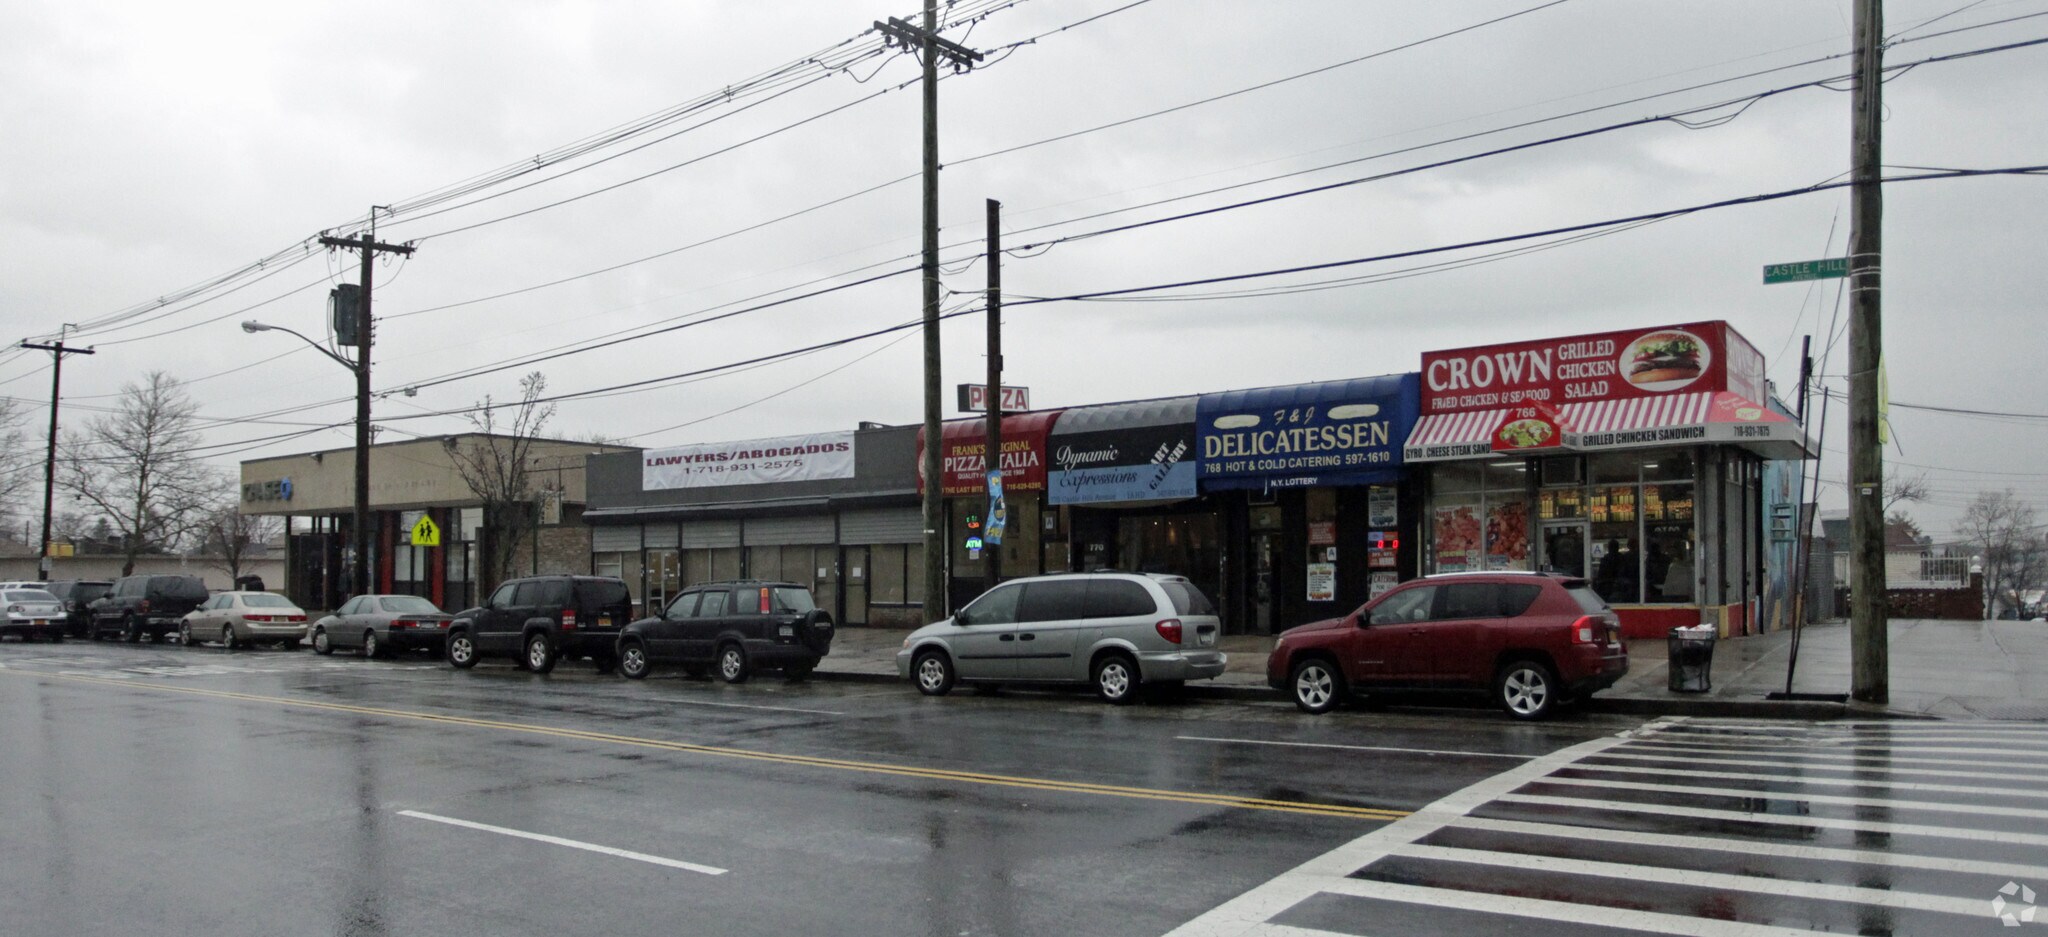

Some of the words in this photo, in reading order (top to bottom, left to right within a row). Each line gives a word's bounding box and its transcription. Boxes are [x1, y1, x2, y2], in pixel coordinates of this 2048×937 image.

[1765, 264, 1810, 277] CASTLE
[1817, 260, 1846, 272] HILL
[1558, 339, 1615, 360] GRILLED
[1427, 348, 1553, 392] CROWN
[1556, 360, 1616, 380] CHICKEN
[970, 387, 1027, 410] PIZA
[1564, 381, 1609, 399] SALAD
[1431, 397, 1457, 410] FRIED
[1460, 393, 1499, 407] CHICKEN
[1501, 392, 1509, 404] &
[1273, 410, 1286, 425] F
[1289, 409, 1299, 423] &
[1304, 406, 1315, 425] J
[1516, 407, 1536, 418] 766
[1205, 421, 1390, 459] DELICATESSEN
[1582, 433, 1614, 447] GRILLED
[1615, 430, 1658, 445] CHINCKEN
[1659, 426, 1705, 441] SANDWICH
[646, 442, 850, 467] LAWYERS/ABOGADOS
[952, 444, 986, 457] FRANK'S
[1000, 440, 1031, 452] IGINAL
[1056, 444, 1120, 471] Dynamic
[1150, 442, 1170, 468] ART
[1405, 448, 1423, 459] GYRO
[1426, 445, 1450, 458] CHEESE
[1451, 444, 1472, 456] STEAK
[683, 459, 803, 475] 1-718-931-2575
[944, 455, 987, 473] PIZZA
[1149, 440, 1188, 490] GALLERY
[1205, 463, 1221, 474] 768
[1225, 461, 1245, 472] HOT
[1248, 461, 1256, 471] &
[1257, 459, 1285, 470] COLD
[1288, 455, 1341, 468] CATERING
[1345, 451, 1390, 464] 597-1610
[956, 486, 970, 494] LAST
[1059, 468, 1138, 493] Expressions
[1271, 479, 1284, 487] N.Y.
[1285, 477, 1318, 486] LOTTERY
[966, 539, 982, 548] ATM
[1090, 543, 1104, 551] 770
